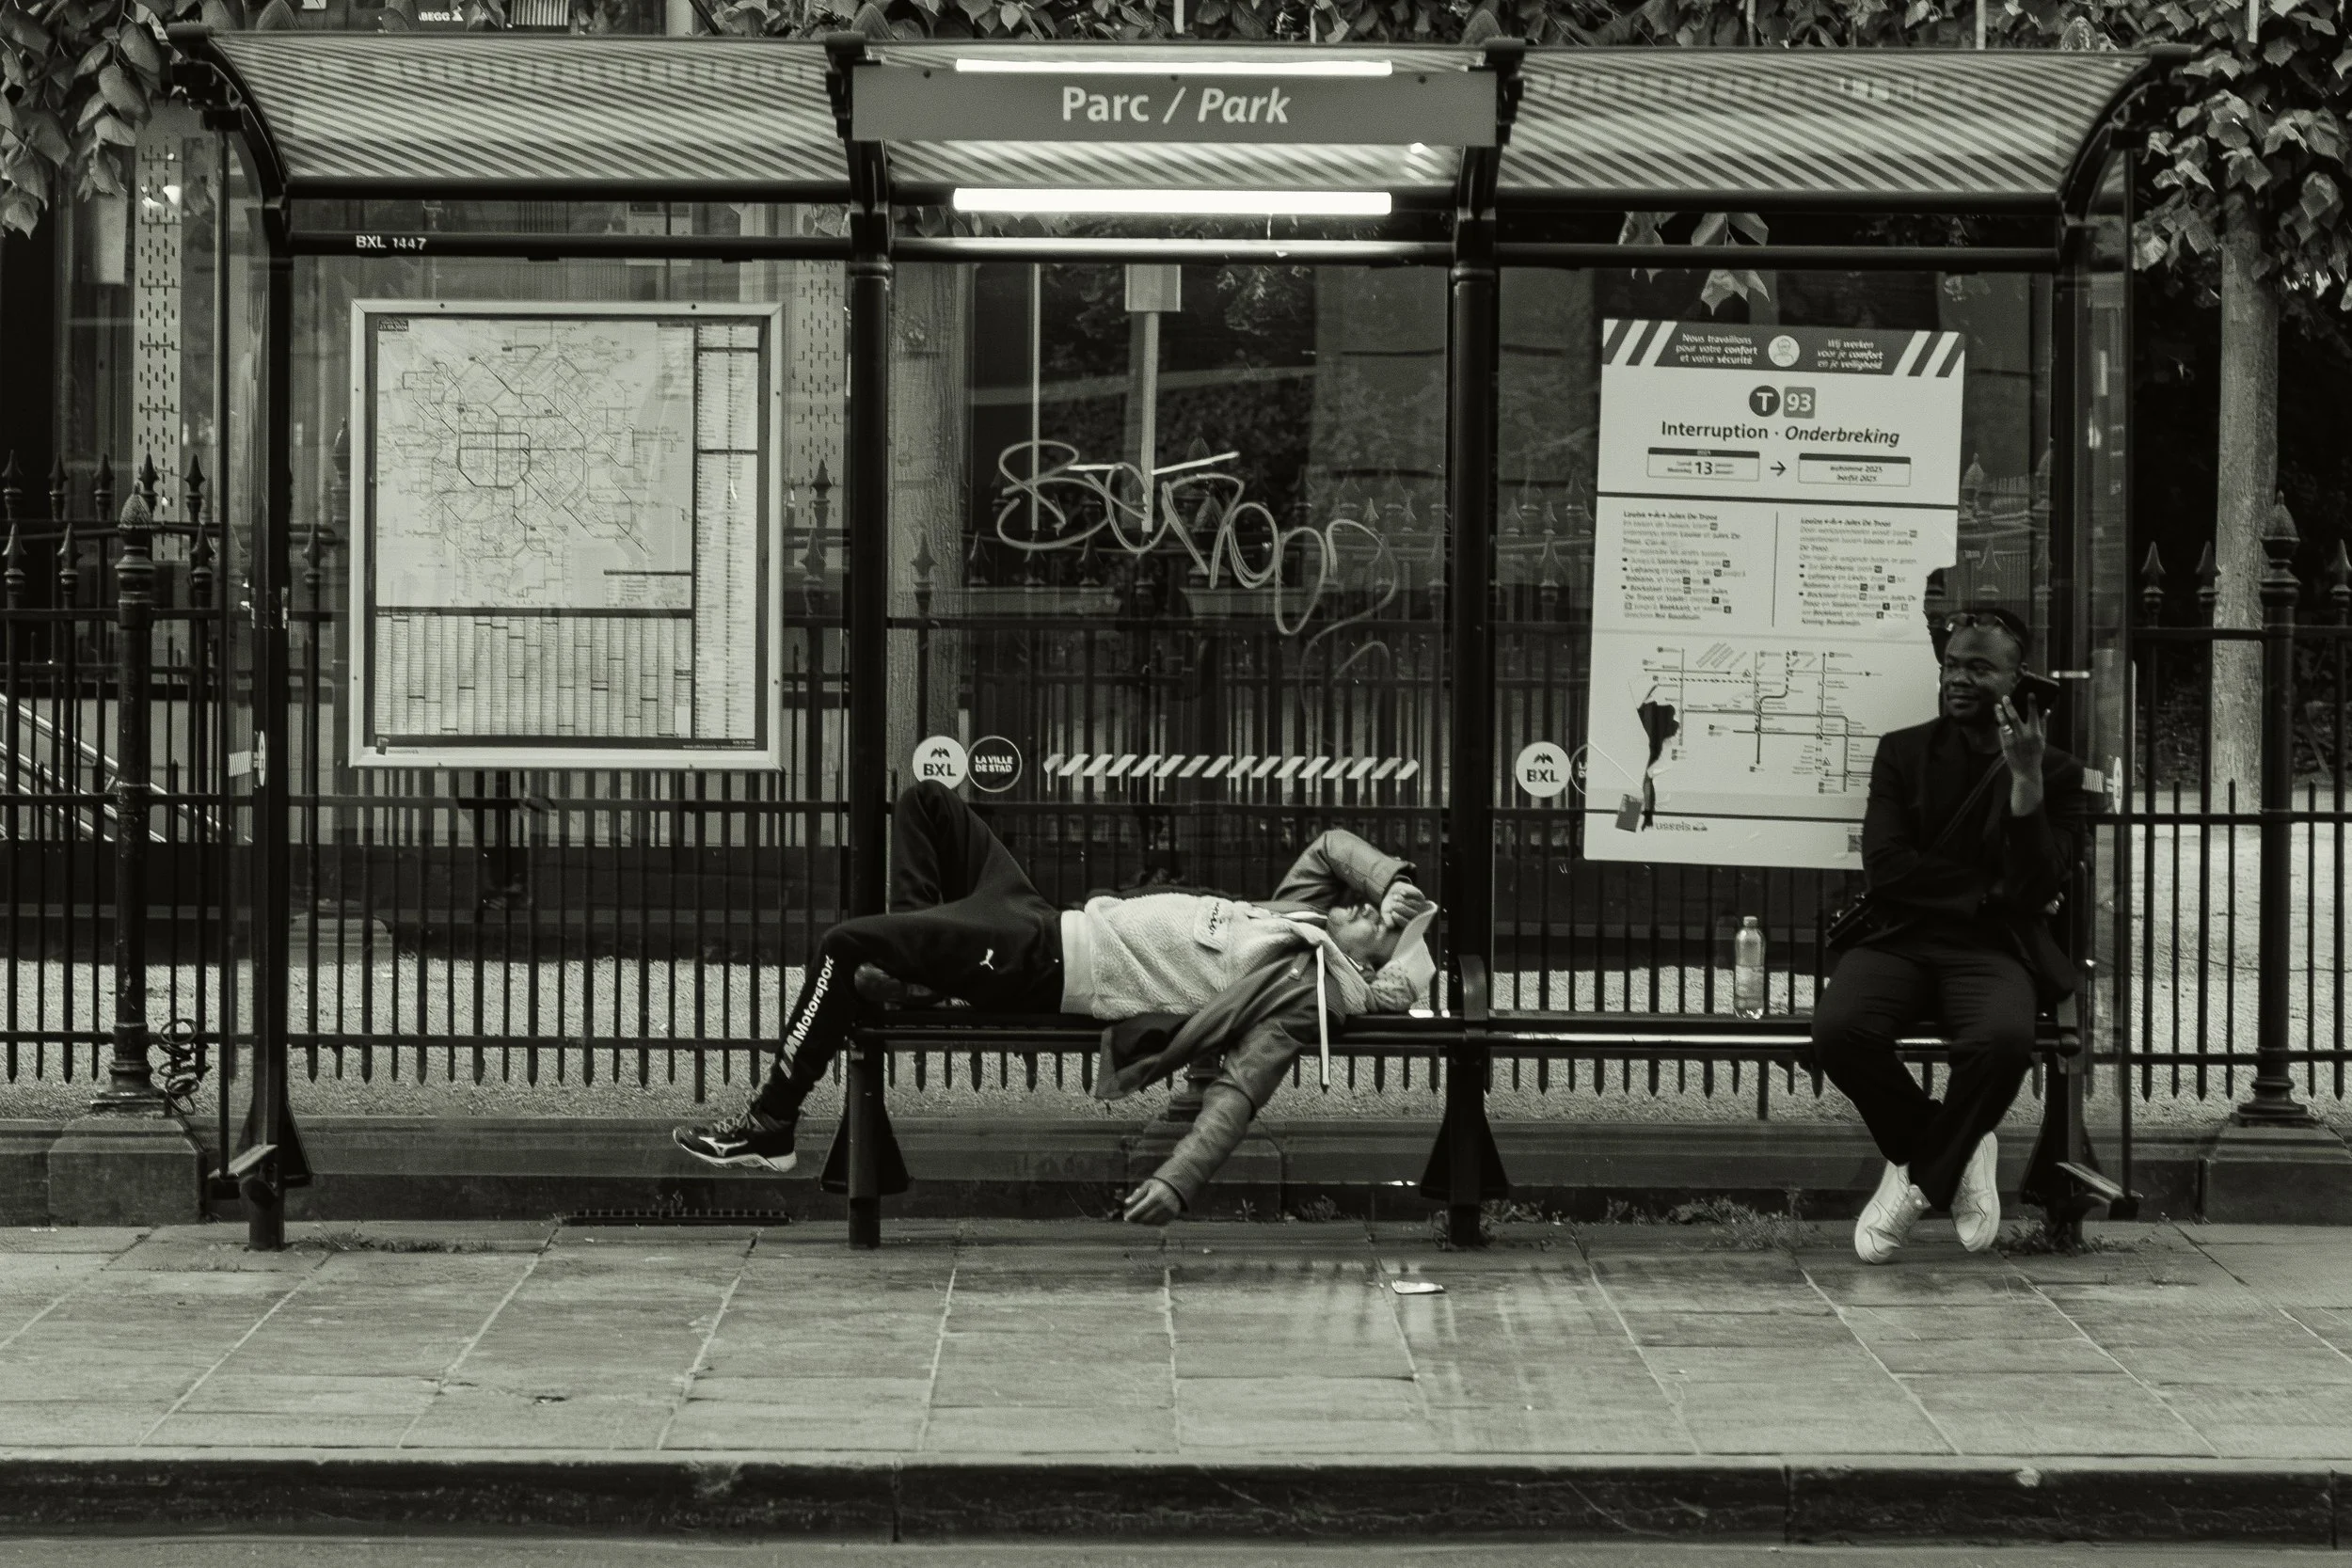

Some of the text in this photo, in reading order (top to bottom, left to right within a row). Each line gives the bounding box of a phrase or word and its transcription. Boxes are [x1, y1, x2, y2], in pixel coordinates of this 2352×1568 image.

[1062, 86, 1150, 121] Parc
[1197, 87, 1292, 123] Park
[356, 234, 427, 251] BXL 1447
[1724, 345, 1758, 356] confort
[1756, 392, 1812, 412] T 93
[1661, 420, 1899, 449] Interruption Onderbreking
[1694, 461, 1713, 475] 13
[975, 755, 1013, 765] LA VILLE
[923, 763, 957, 777] BXL
[975, 764, 1012, 773] DE STAD
[1526, 768, 1560, 783] BXL
